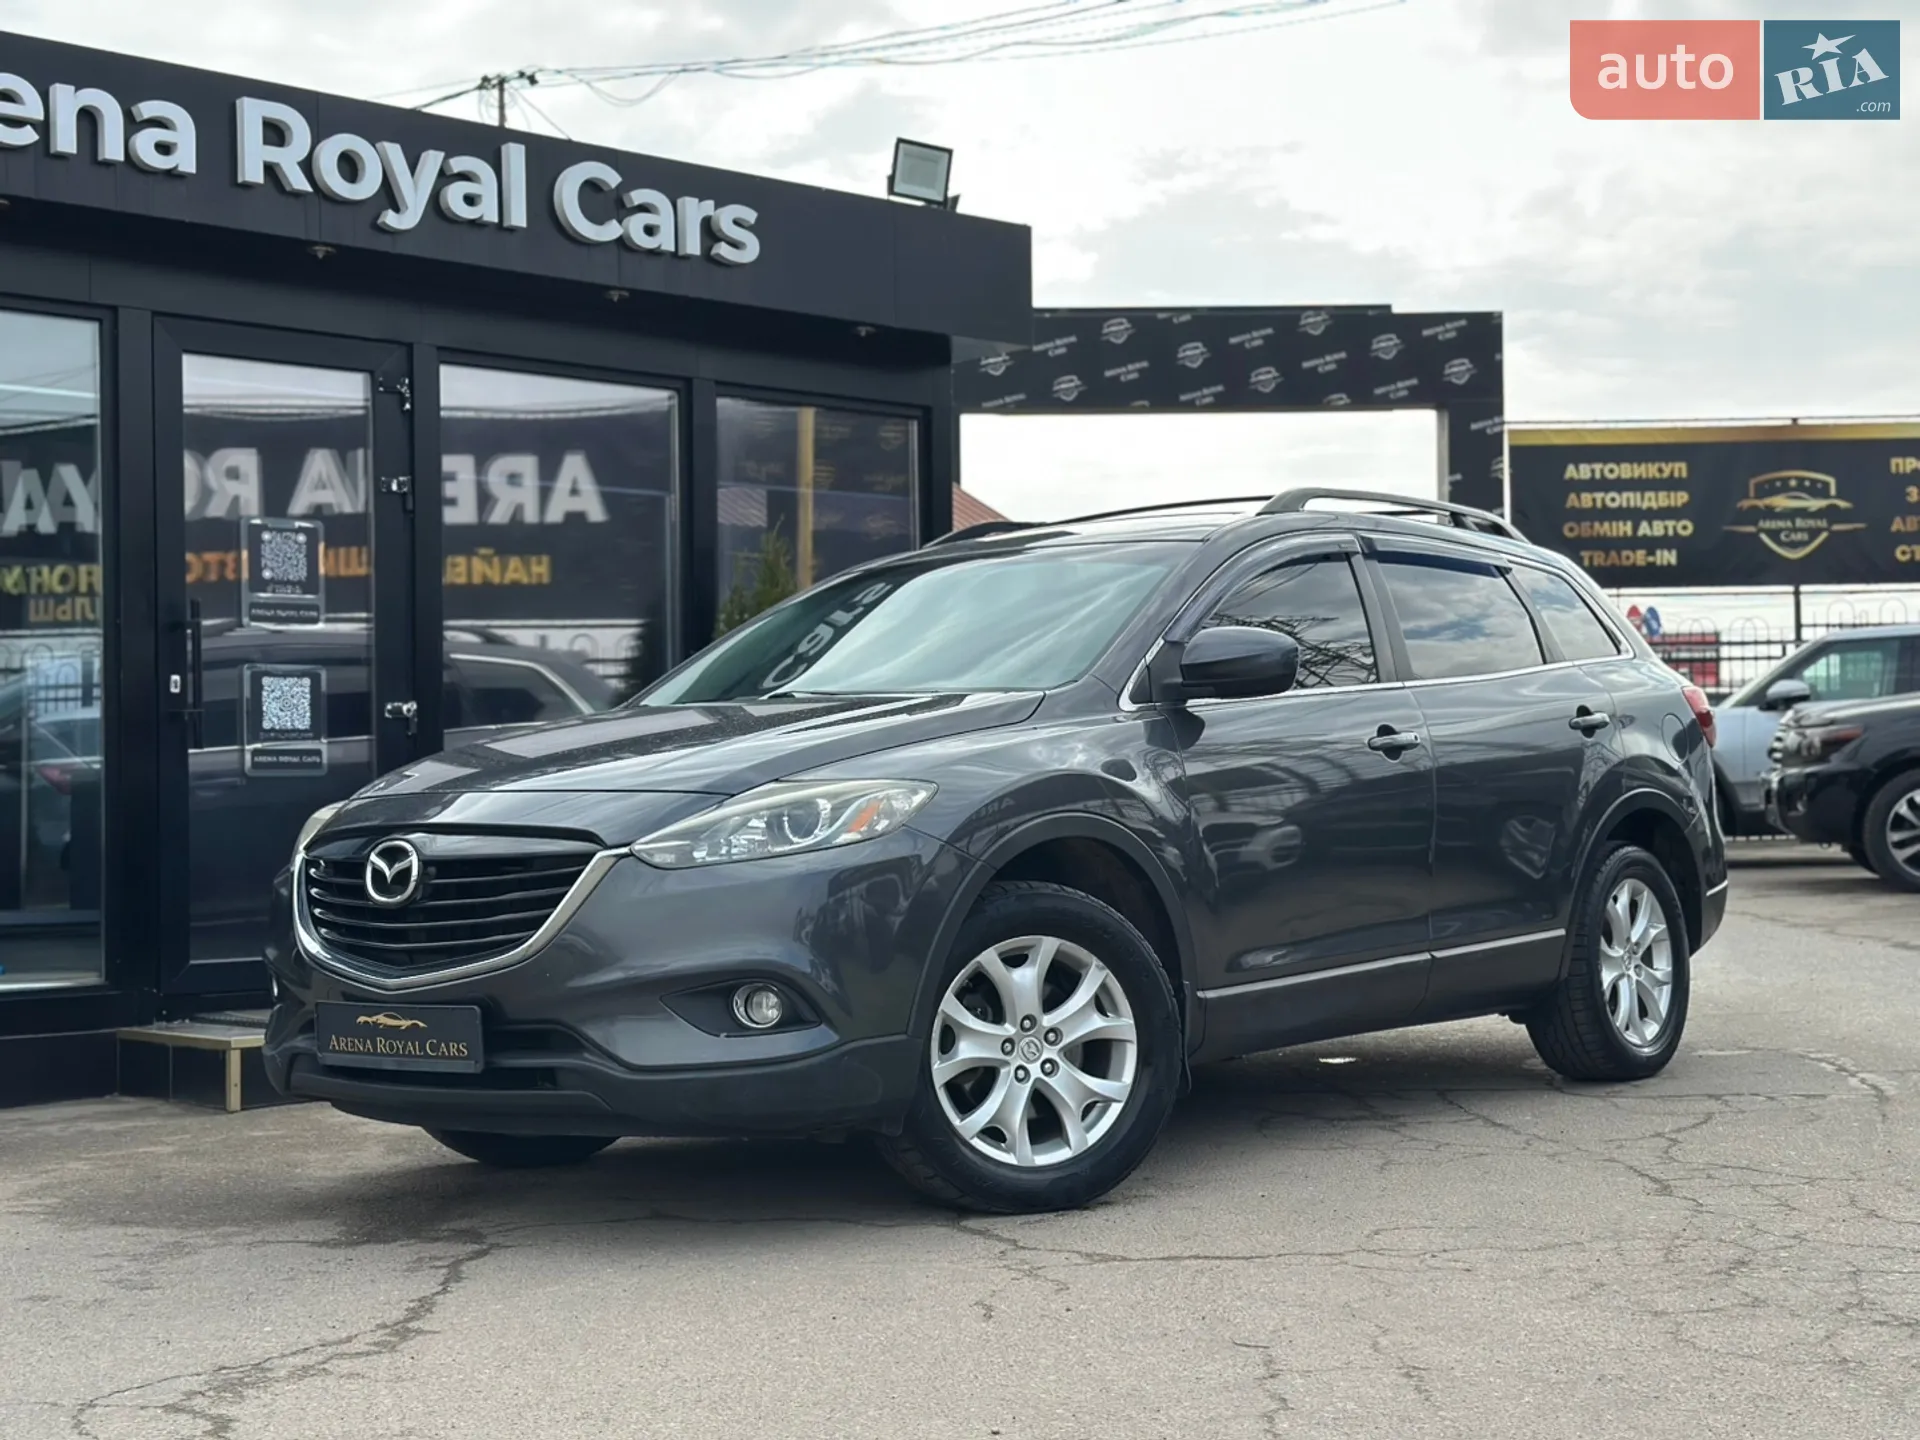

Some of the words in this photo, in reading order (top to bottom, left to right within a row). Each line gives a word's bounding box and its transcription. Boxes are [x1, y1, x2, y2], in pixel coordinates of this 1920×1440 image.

[236, 96, 528, 232] Royal
[553, 160, 760, 266] Cars
[1563, 461, 1688, 480] АВТОВИКУП
[1889, 456, 1920, 475] ПР
[1565, 491, 1690, 510] АВТОПІДБІР
[1562, 520, 1633, 538] ОБМІН
[1636, 519, 1694, 537] АВТО
[1579, 549, 1678, 568] TRADE-IN
[328, 1034, 374, 1054] ARENA
[376, 1036, 424, 1056] ROYAL
[426, 1038, 468, 1058] CARS
